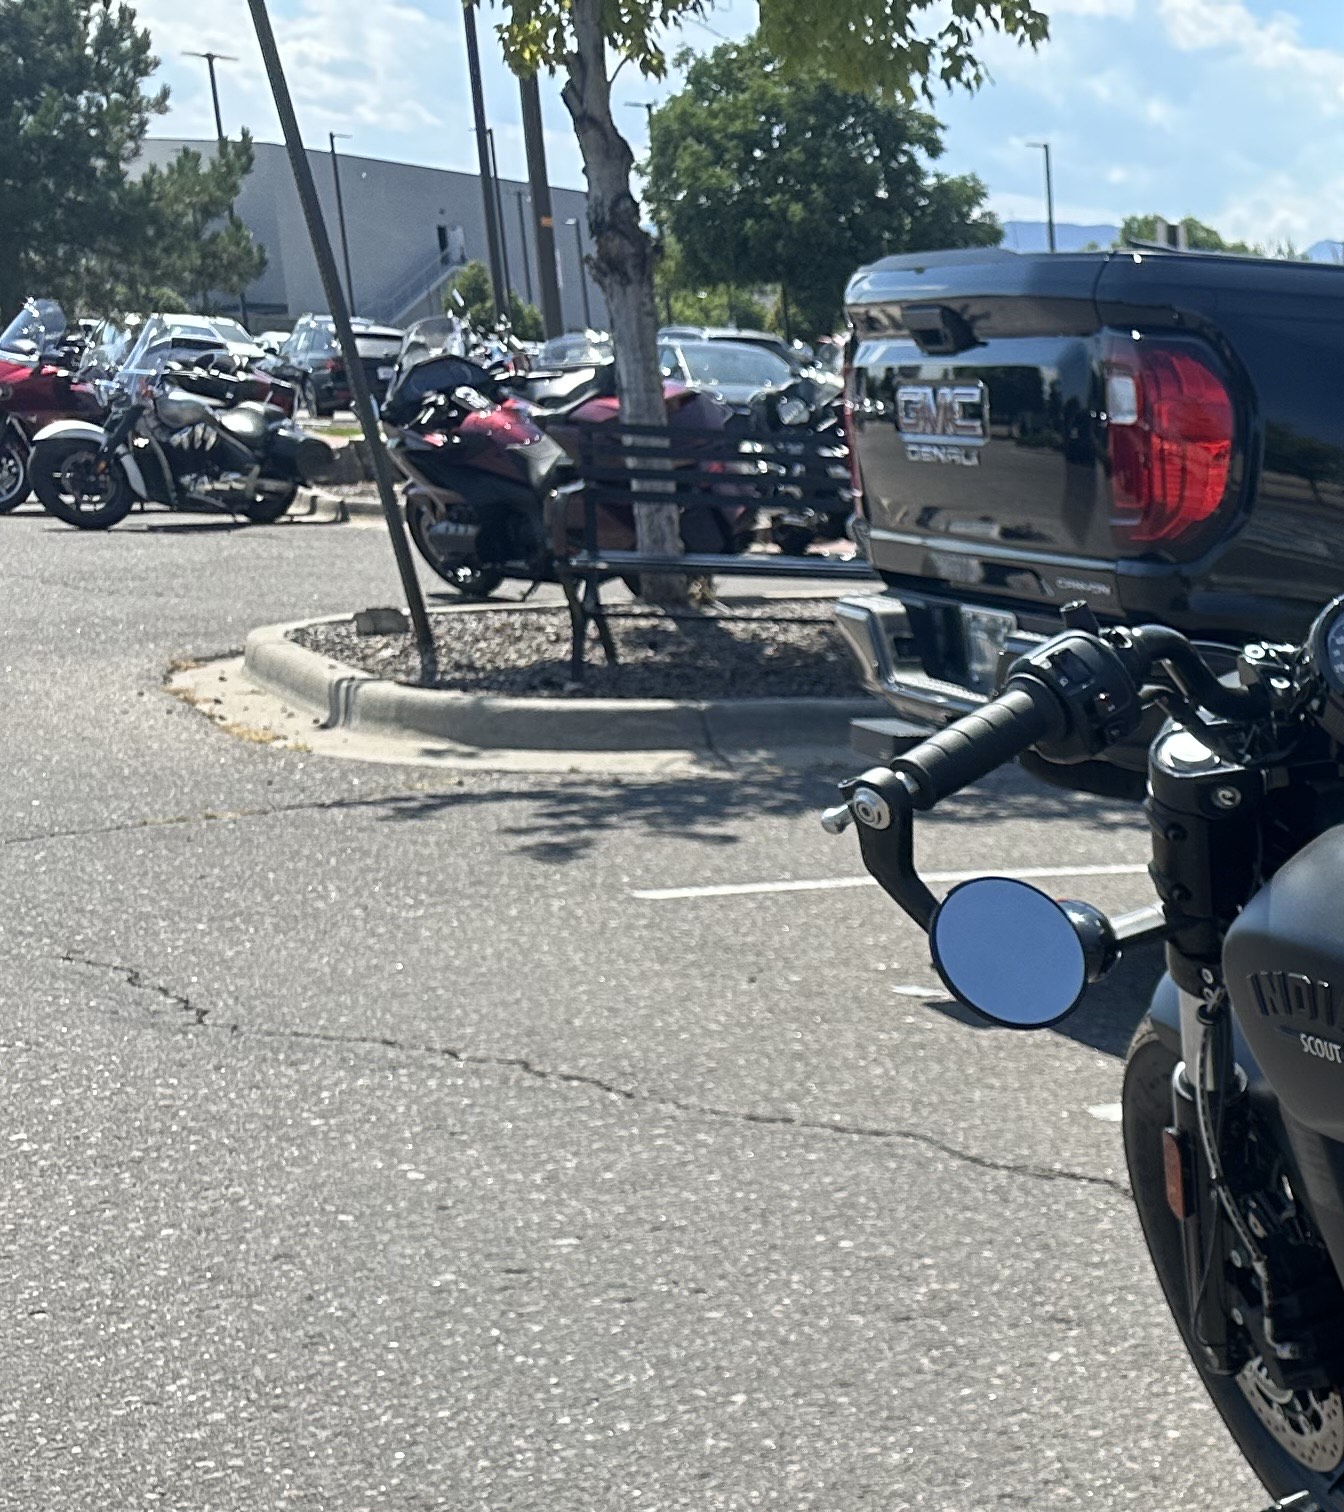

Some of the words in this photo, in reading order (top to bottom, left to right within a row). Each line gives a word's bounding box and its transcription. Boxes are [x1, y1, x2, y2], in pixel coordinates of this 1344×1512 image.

[897, 386, 983, 435] GMC
[905, 443, 980, 466] DENALI
[1300, 1033, 1343, 1063] SCOUT
